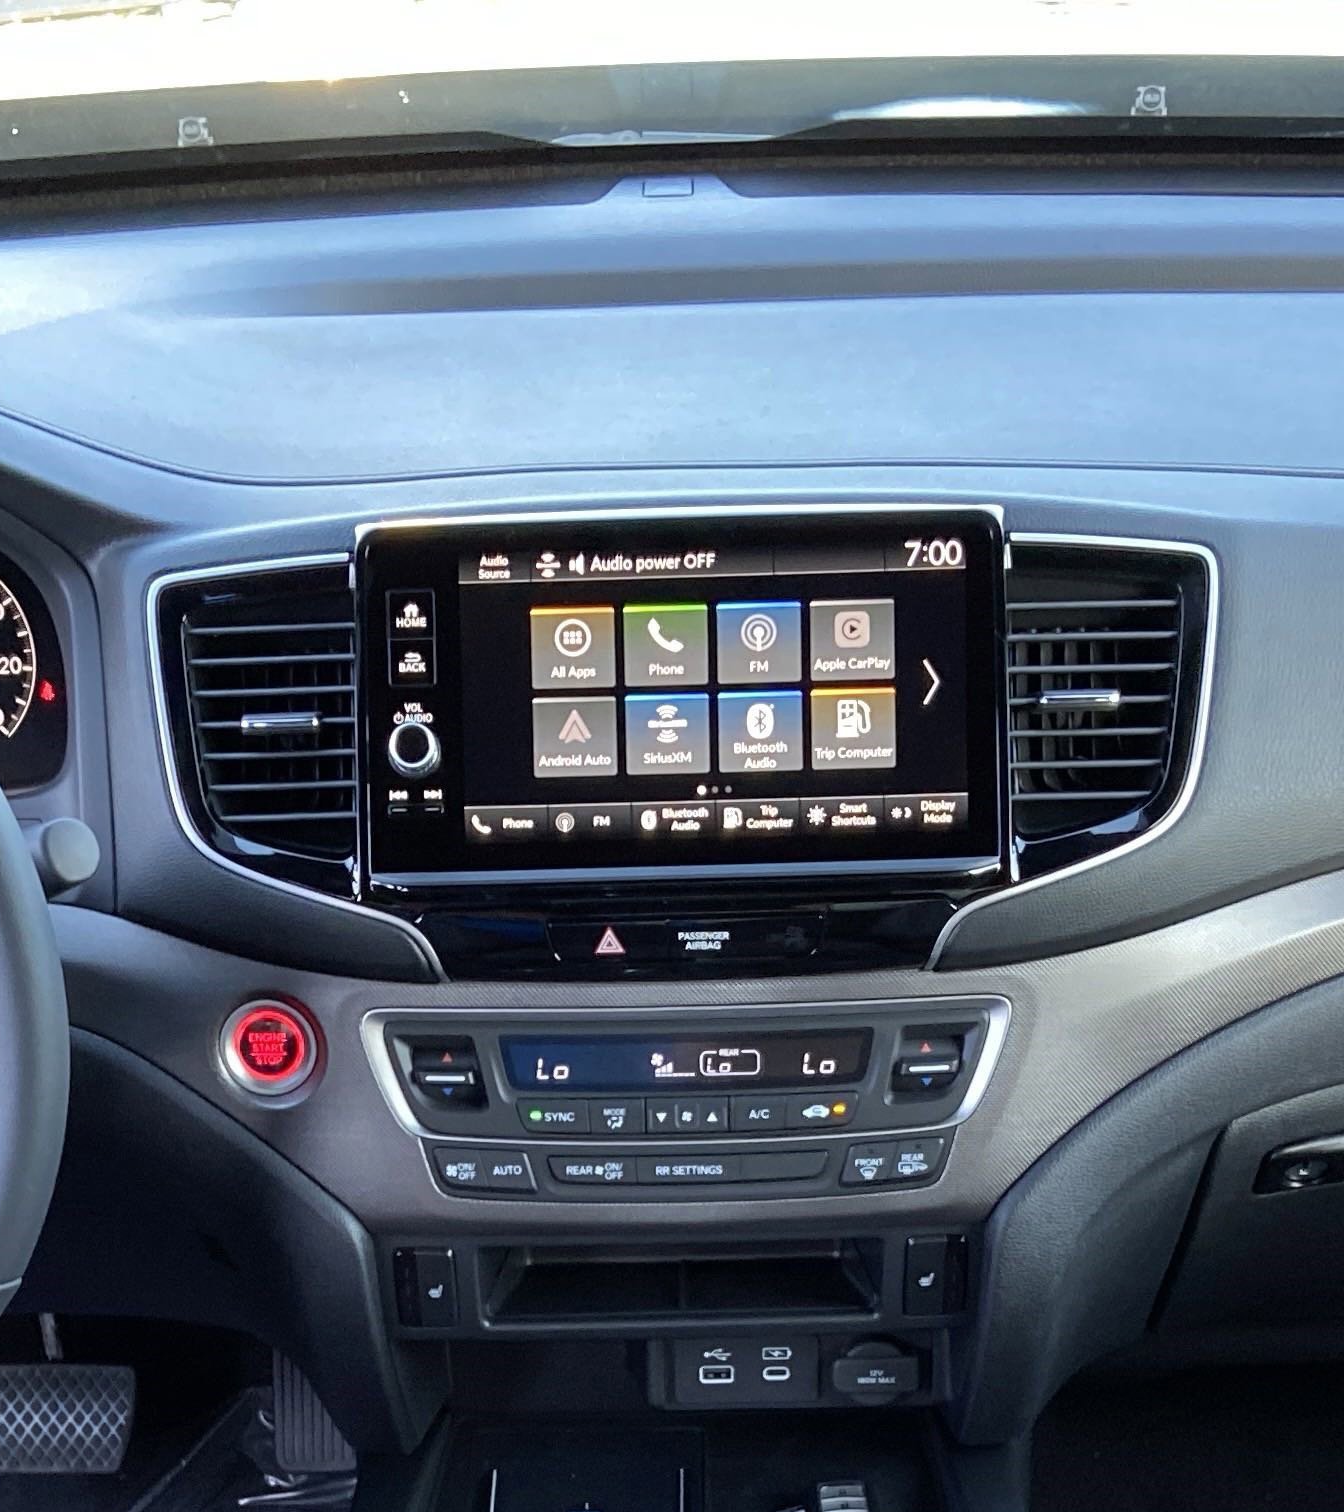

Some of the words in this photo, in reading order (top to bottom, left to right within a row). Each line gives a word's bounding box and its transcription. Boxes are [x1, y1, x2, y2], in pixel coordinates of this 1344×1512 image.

[905, 540, 962, 567] 7:00
[480, 555, 508, 567] Audio
[590, 555, 632, 572] Audio
[635, 555, 680, 573] power
[684, 553, 716, 569] OFF
[478, 569, 510, 579] Source
[396, 617, 426, 628] HOME
[399, 662, 426, 672] BACK
[649, 664, 684, 675] Phone
[749, 661, 769, 672] FM
[814, 658, 846, 672] Apple
[848, 657, 891, 671] CarPlay
[551, 666, 571, 678] All
[573, 666, 596, 680] Apps
[404, 702, 423, 712] VOL
[405, 713, 433, 722] AUDIO
[734, 741, 787, 754] Bluetooth
[644, 752, 692, 764] SiriusXM
[815, 748, 835, 761] Trip
[838, 747, 892, 760] Computer
[539, 754, 582, 767] Android
[584, 754, 611, 765] Auto
[744, 757, 777, 769] Audio
[760, 805, 778, 817] Trip
[840, 803, 867, 814] Smart
[921, 800, 955, 812] Display
[662, 808, 709, 819] Bluetooth
[924, 814, 953, 824] Mode
[503, 818, 534, 828] Phone
[593, 816, 610, 827] FM
[671, 820, 700, 831] Audio
[746, 818, 793, 829] Computer
[831, 816, 876, 827] Shortcuts
[678, 932, 729, 940] PASSENGER
[685, 941, 721, 950] AIRBAG
[249, 1032, 287, 1042] ENGINE
[252, 1043, 284, 1052] START
[719, 1048, 739, 1056] REAR
[256, 1056, 283, 1064] STOP
[706, 1057, 731, 1073] Lo
[803, 1053, 835, 1075] Lo
[536, 1058, 569, 1080] Lo
[544, 1111, 575, 1122] SYNC
[603, 1108, 626, 1116] MODE
[749, 1108, 769, 1120] A/C
[855, 1158, 883, 1167] FRONT
[901, 1153, 924, 1161] REAR
[457, 1162, 476, 1171] ON/
[493, 1165, 522, 1176] AUTO
[566, 1165, 593, 1175] REAR
[605, 1162, 623, 1171] ON/
[655, 1166, 670, 1176] RR
[671, 1165, 723, 1176] SETTINGS
[458, 1171, 476, 1181] OFF
[605, 1171, 624, 1181] OFF
